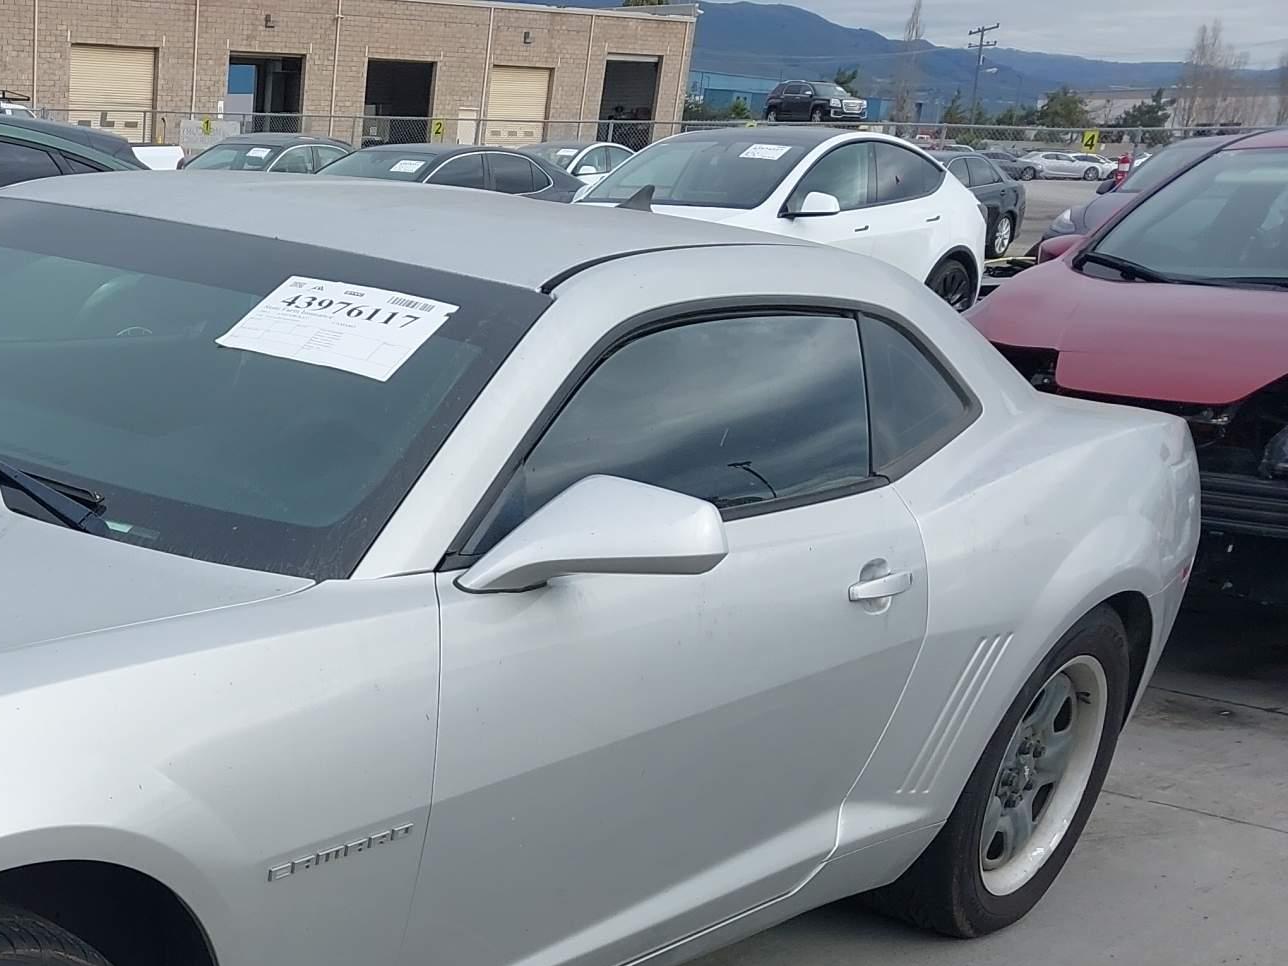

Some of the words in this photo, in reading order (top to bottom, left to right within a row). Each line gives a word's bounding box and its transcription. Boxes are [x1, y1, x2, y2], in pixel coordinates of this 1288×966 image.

[202, 119, 210, 131] 1
[434, 121, 443, 135] 2
[1083, 133, 1096, 151] 4
[280, 293, 422, 329] 43976117
